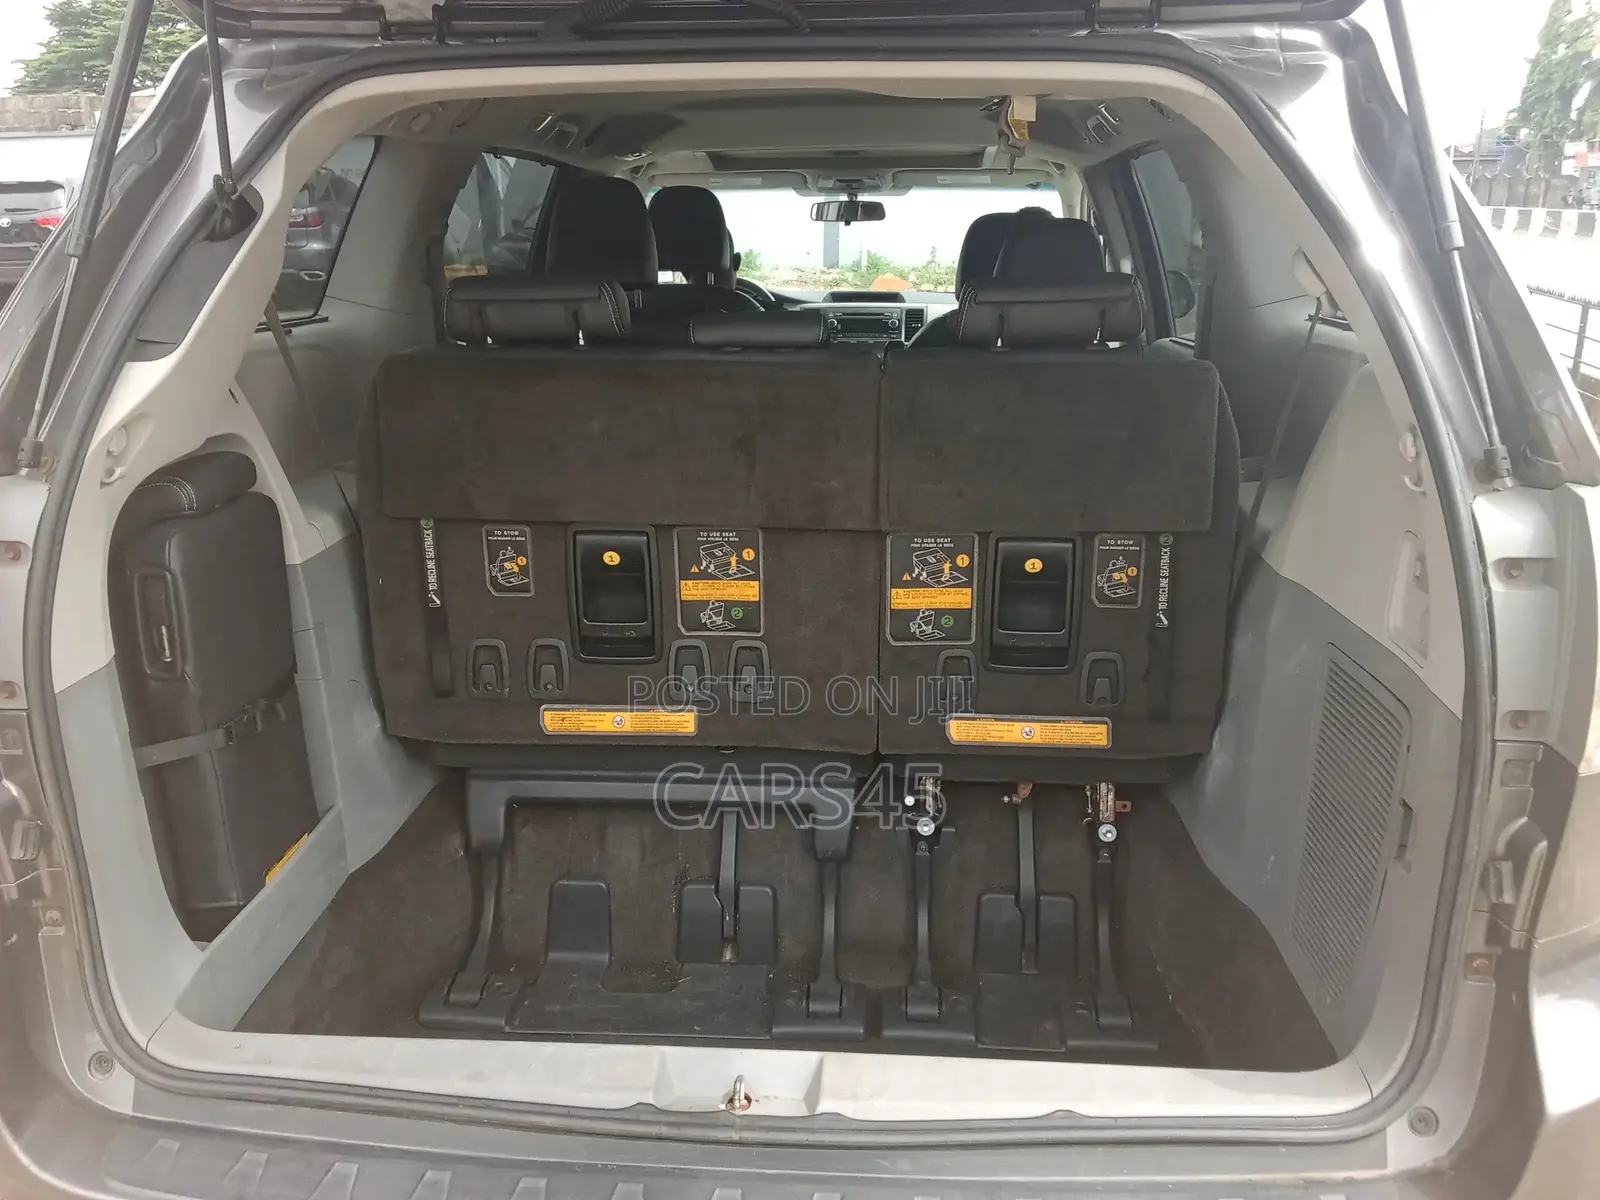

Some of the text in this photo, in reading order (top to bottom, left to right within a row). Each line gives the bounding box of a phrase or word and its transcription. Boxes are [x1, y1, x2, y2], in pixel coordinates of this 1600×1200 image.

[423, 529, 435, 558] SEATBACK
[426, 559, 437, 582] RECLINE
[1160, 547, 1171, 576] SEATBACK
[1158, 577, 1169, 601] RECLINE
[1158, 601, 1168, 610] TO
